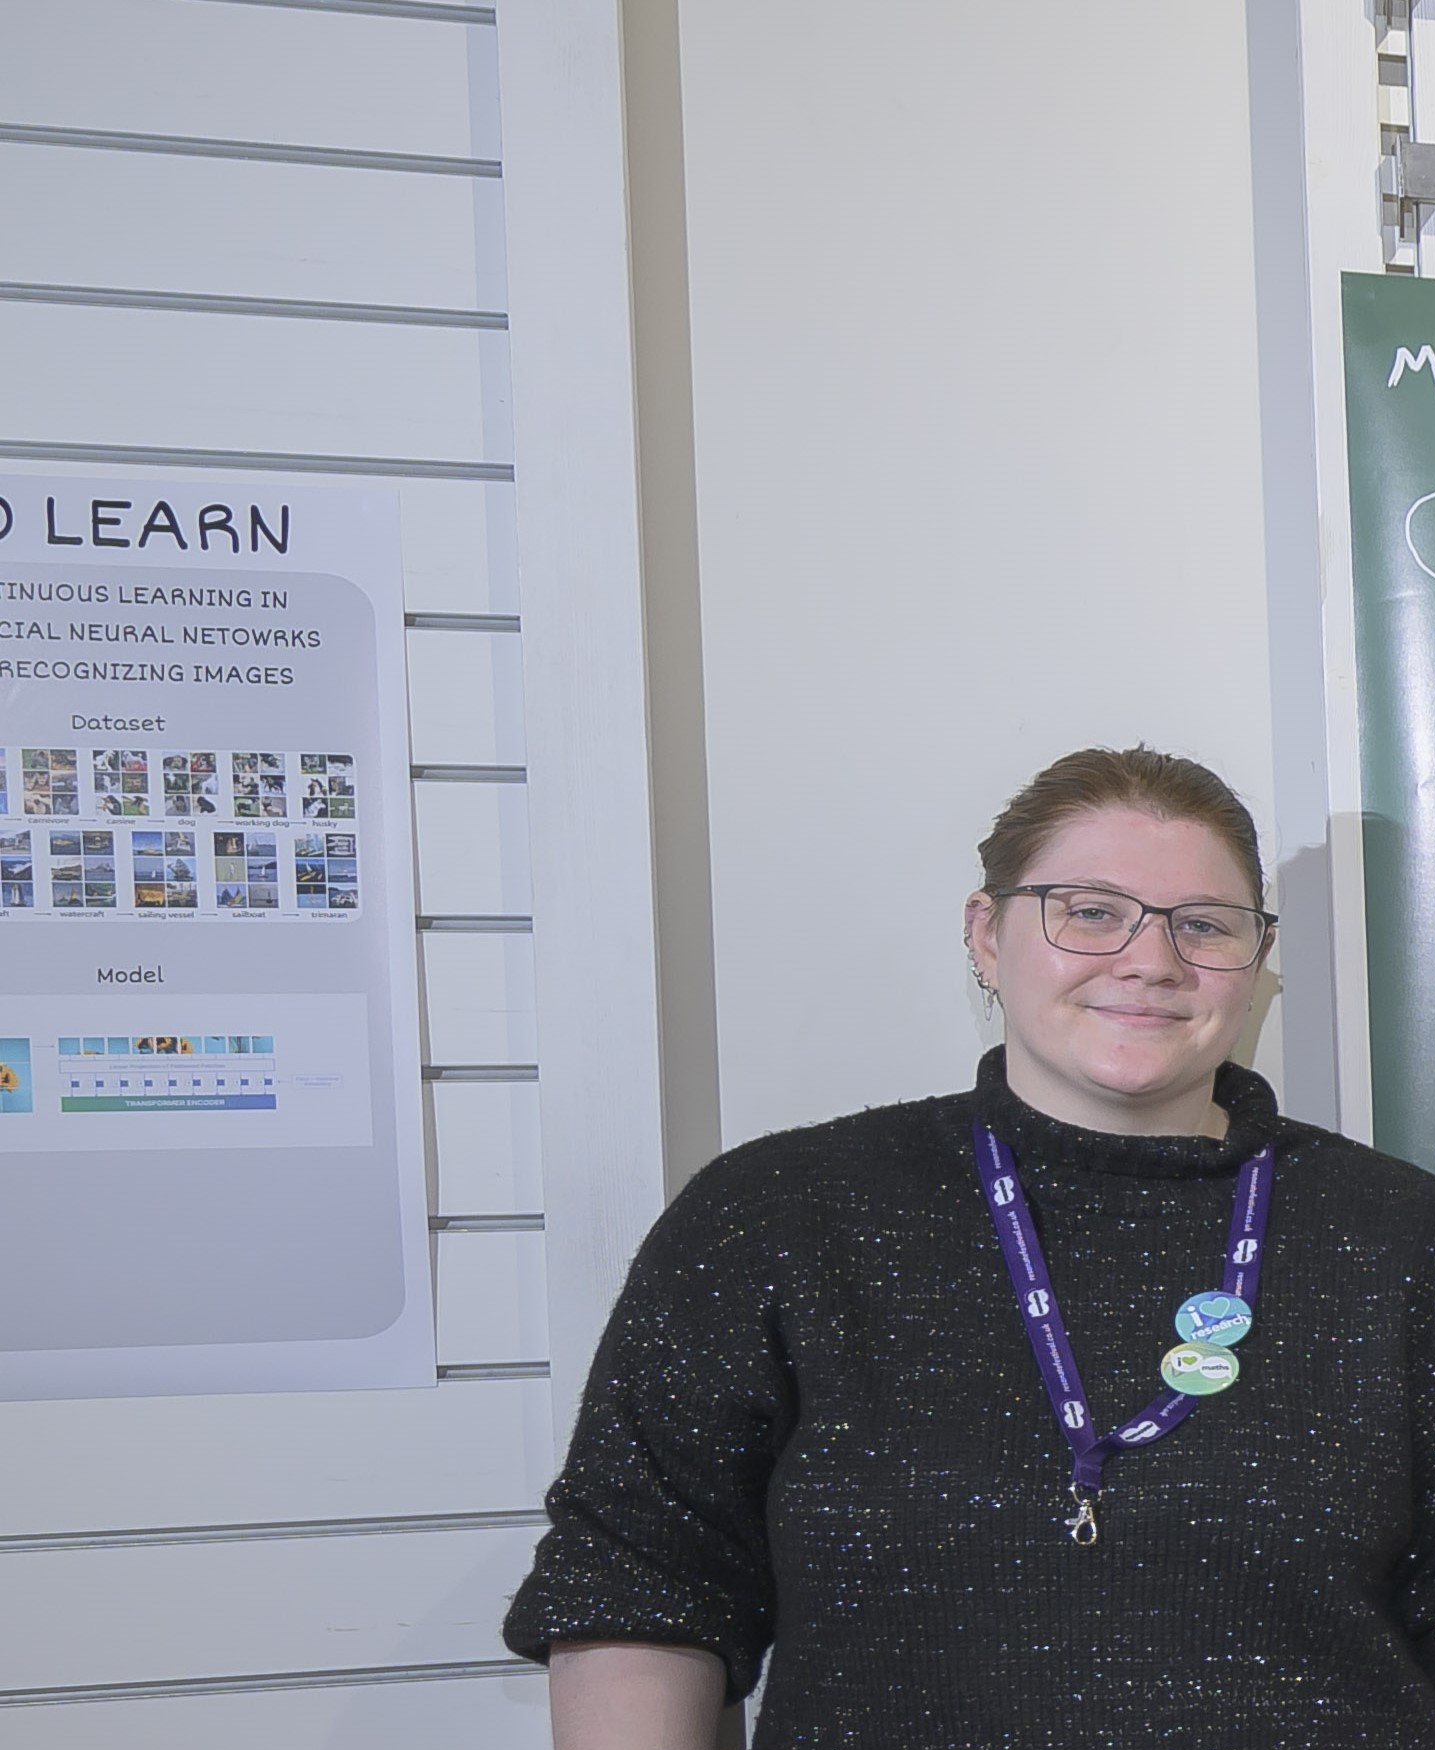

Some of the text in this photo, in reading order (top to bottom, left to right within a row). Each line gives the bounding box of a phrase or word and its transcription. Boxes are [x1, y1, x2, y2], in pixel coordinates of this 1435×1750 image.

[47, 497, 289, 554] LEARN
[119, 586, 251, 607] LEARNING
[261, 591, 287, 608] IN
[70, 623, 174, 643] NEURAL
[184, 627, 320, 648] NETOWRKS
[0, 661, 293, 684] RECOGNIZING IMAGES
[72, 715, 165, 731] Dataset
[98, 966, 164, 983] Model
[1191, 1313, 1251, 1340] research
